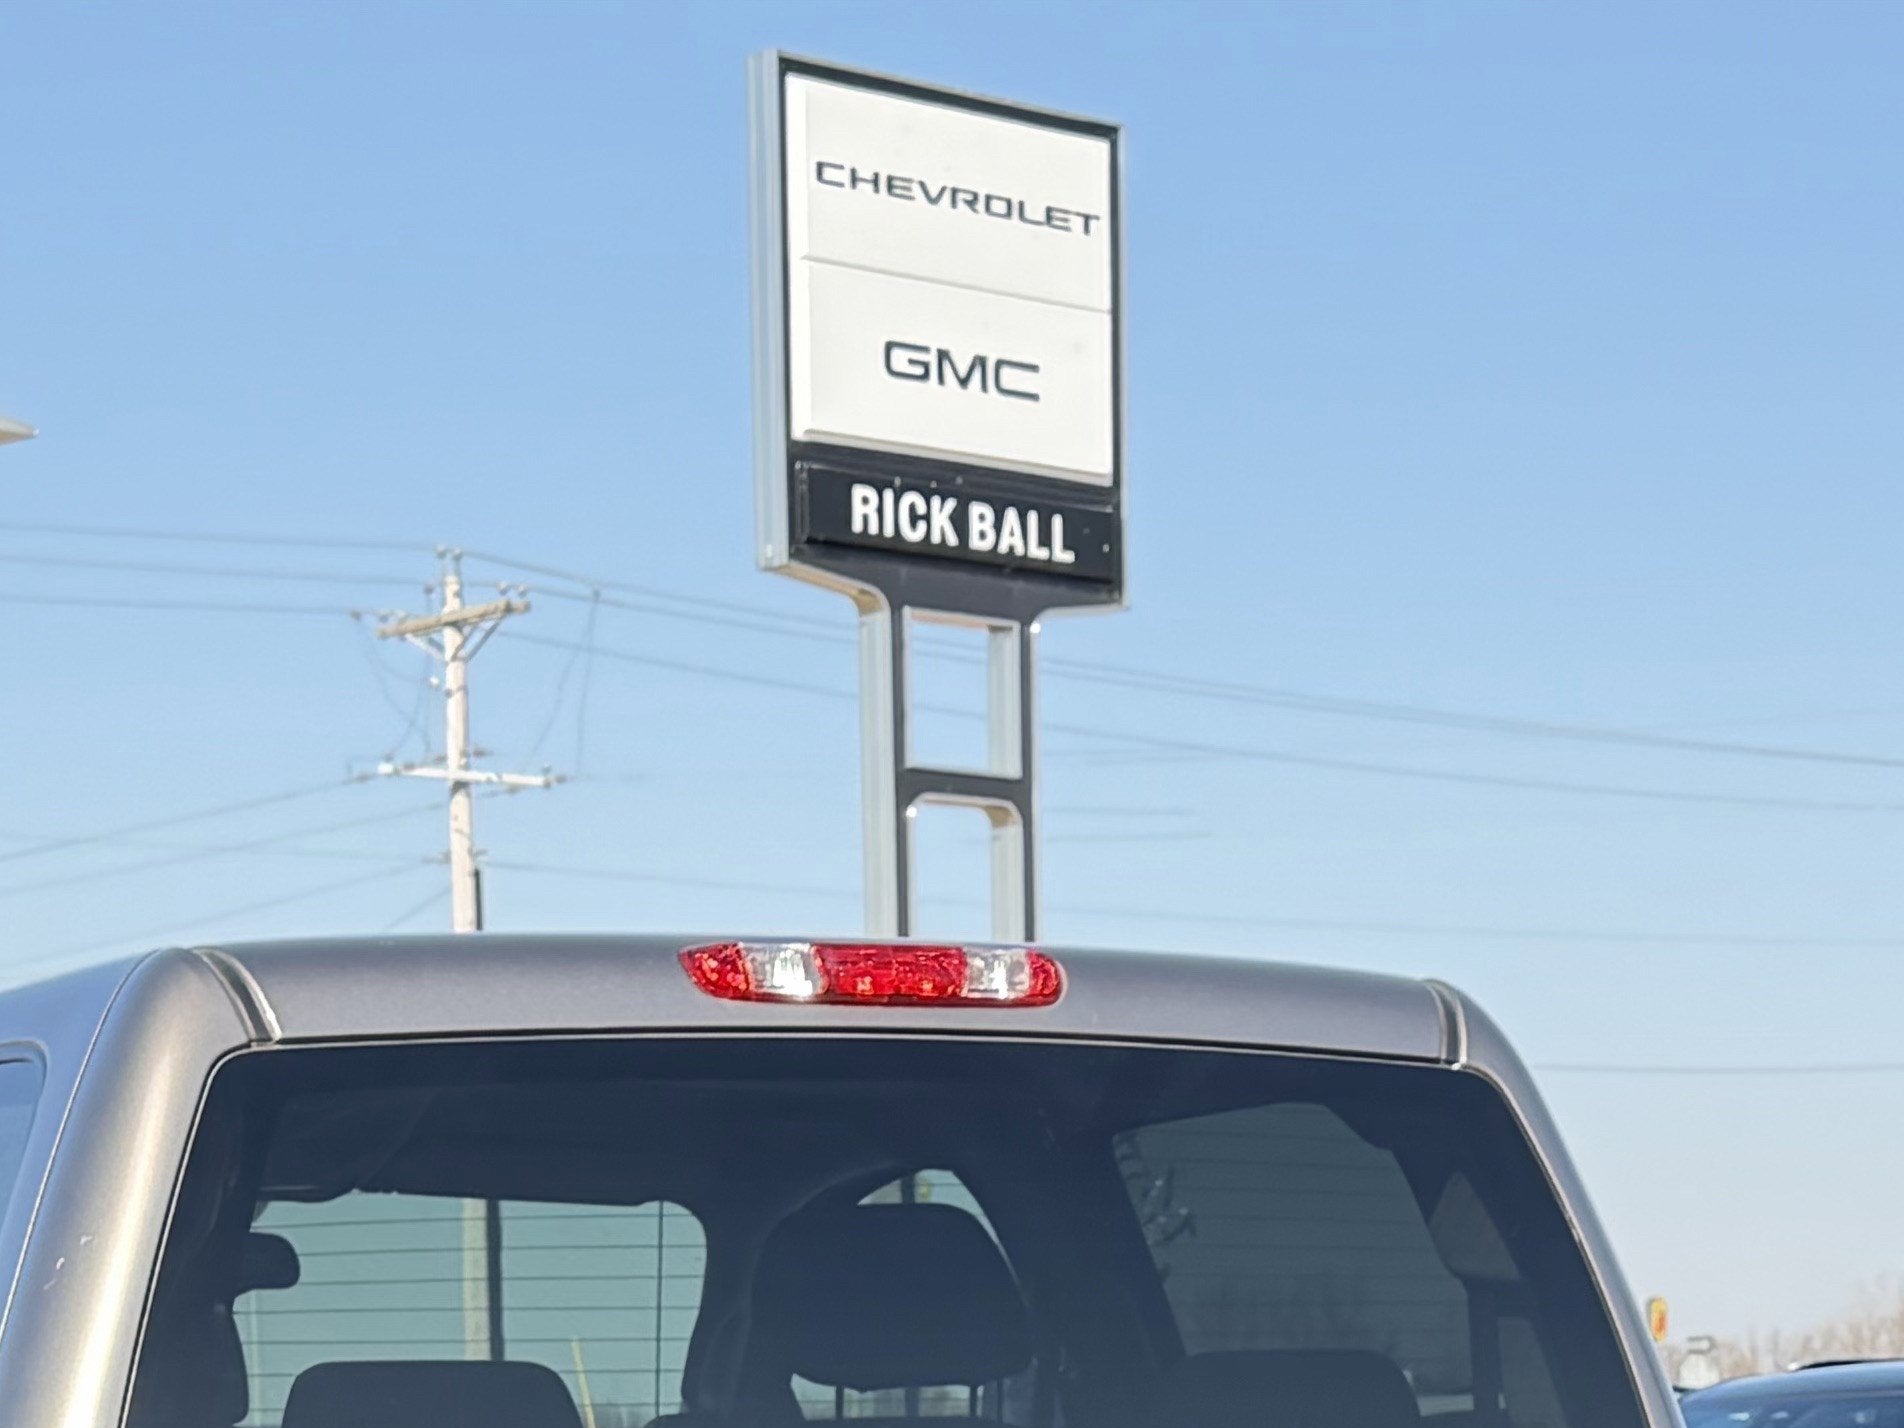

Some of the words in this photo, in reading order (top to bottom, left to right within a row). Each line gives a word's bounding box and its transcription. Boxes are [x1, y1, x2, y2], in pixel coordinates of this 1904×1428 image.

[815, 160, 1100, 237] CHEVROLET
[884, 339, 1041, 402] GMC
[850, 481, 959, 548] RICK
[968, 500, 1075, 564] BALL
